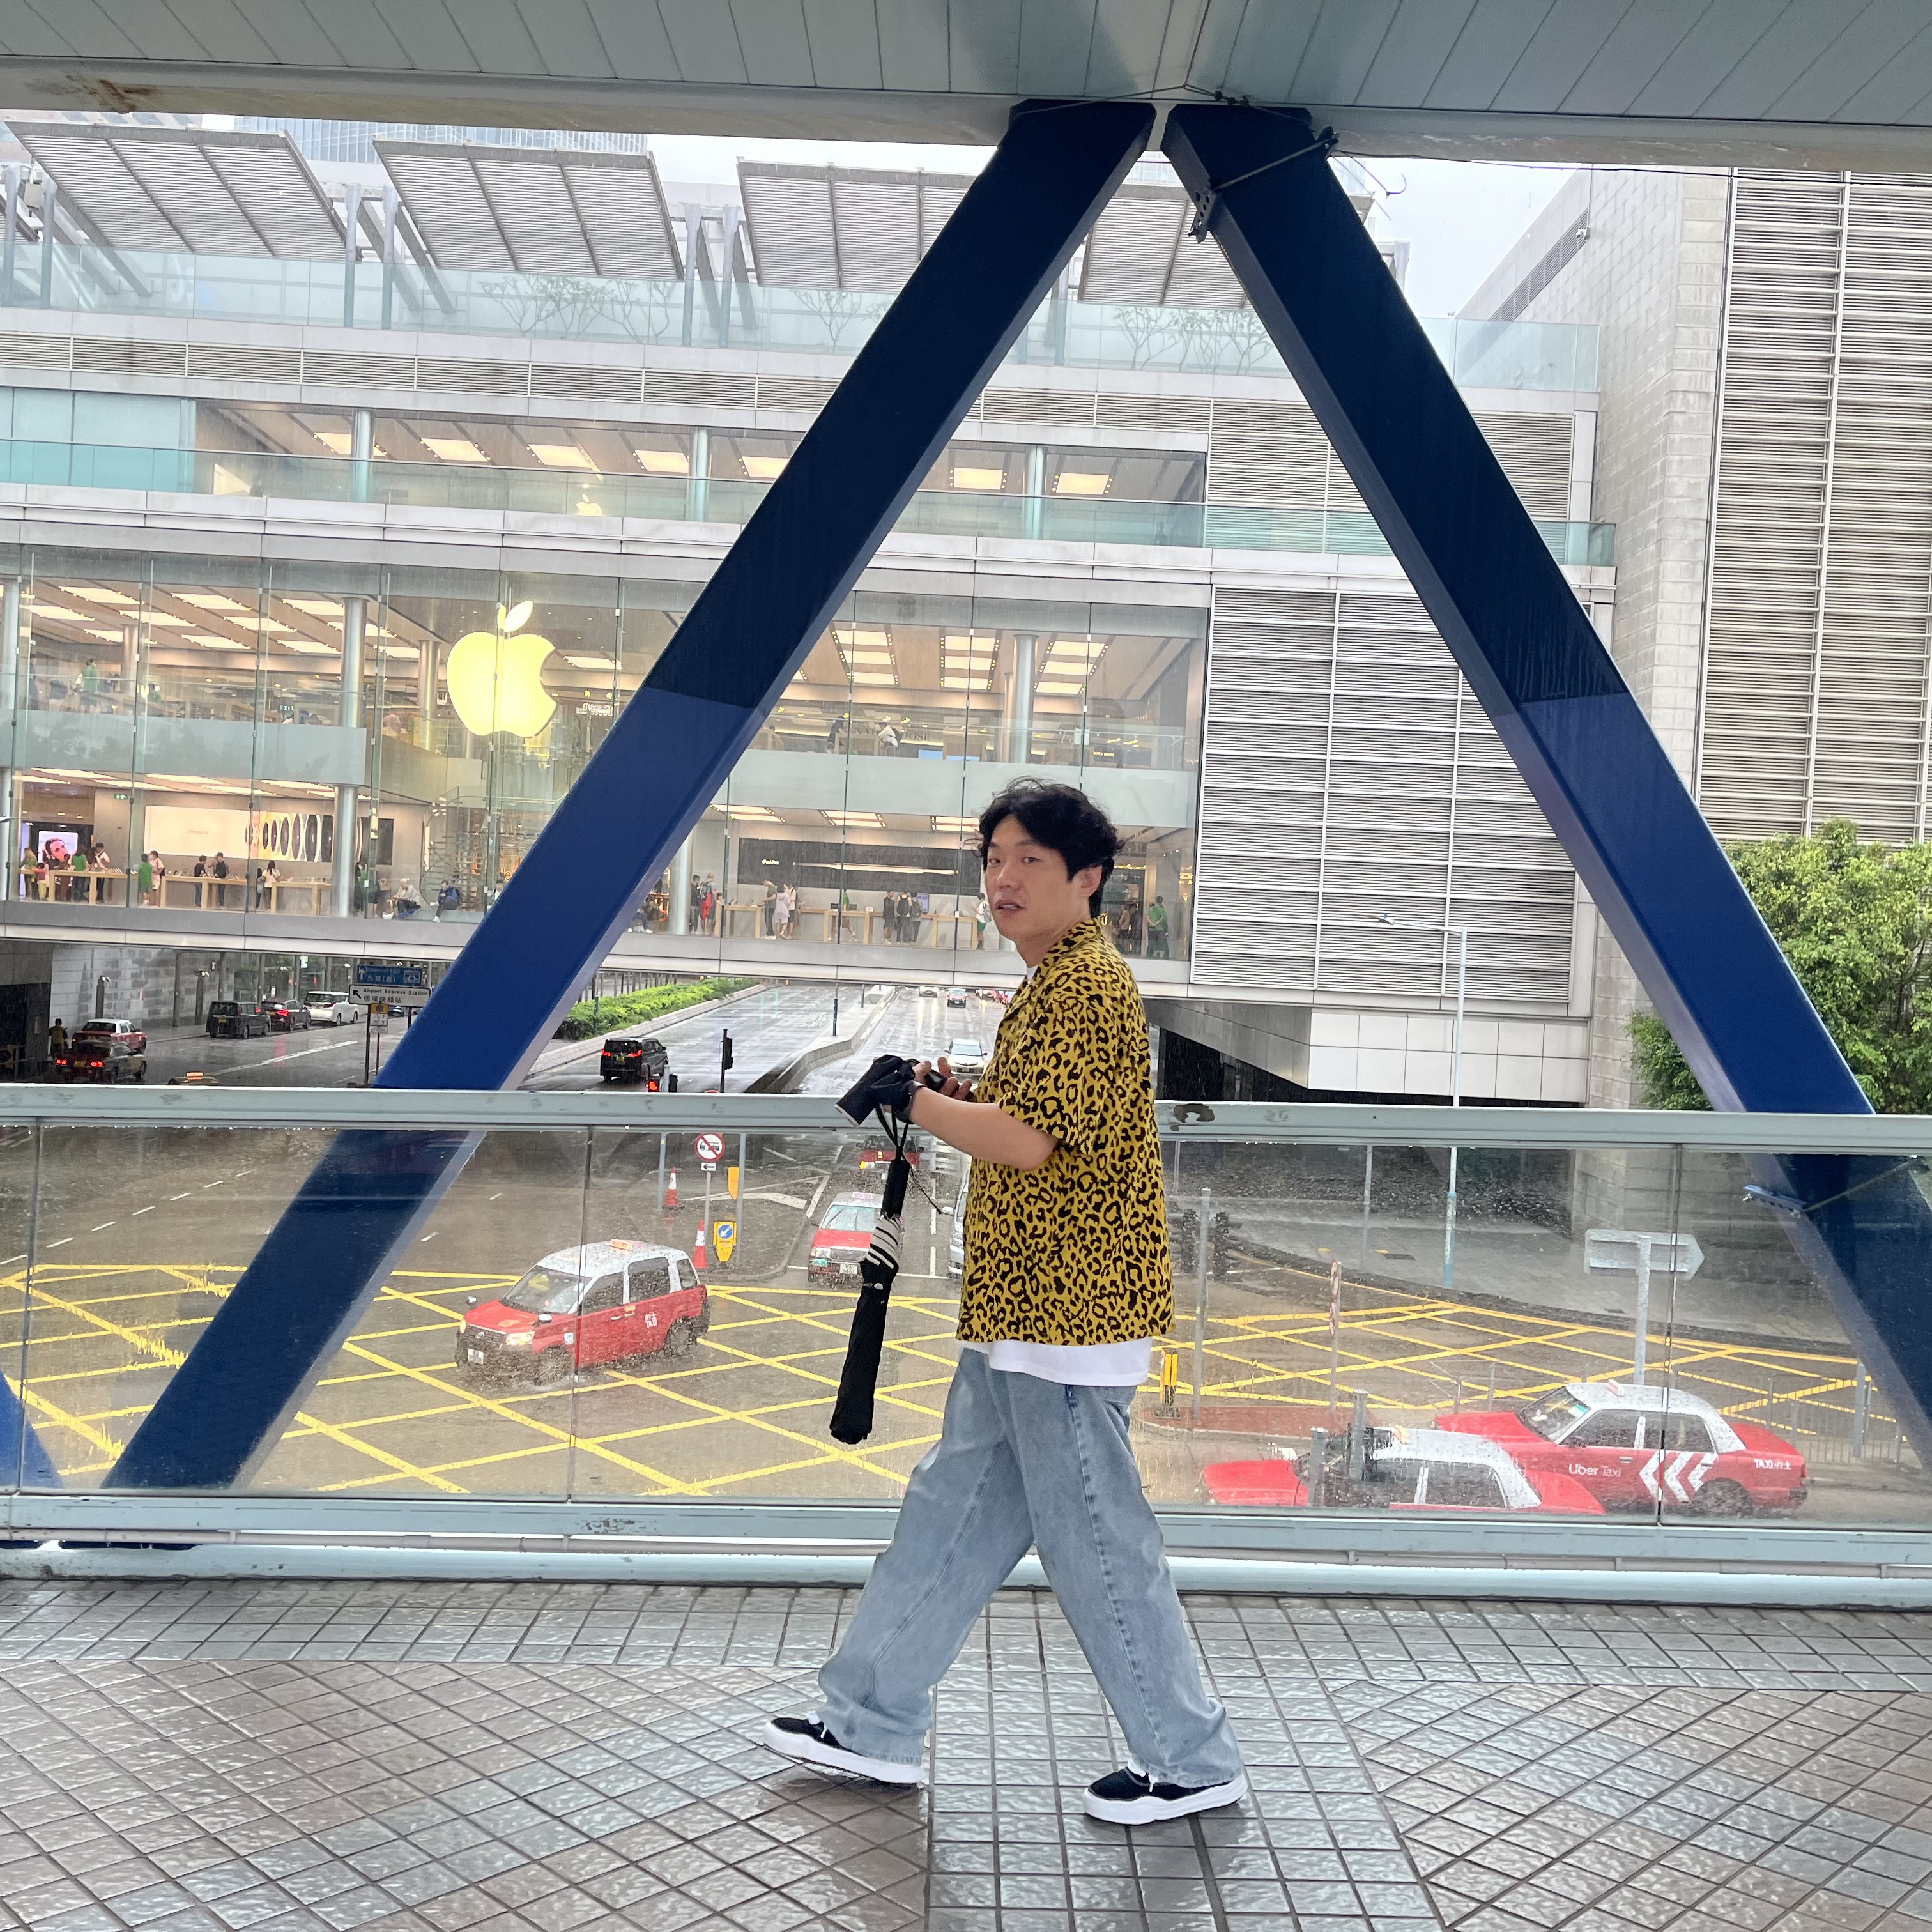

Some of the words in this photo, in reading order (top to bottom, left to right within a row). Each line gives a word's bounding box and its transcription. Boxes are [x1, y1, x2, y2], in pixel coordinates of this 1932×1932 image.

[1754, 1459, 1773, 1469] TAXI
[1568, 1464, 1598, 1476] Uber
[1601, 1465, 1621, 1477] Taxi
